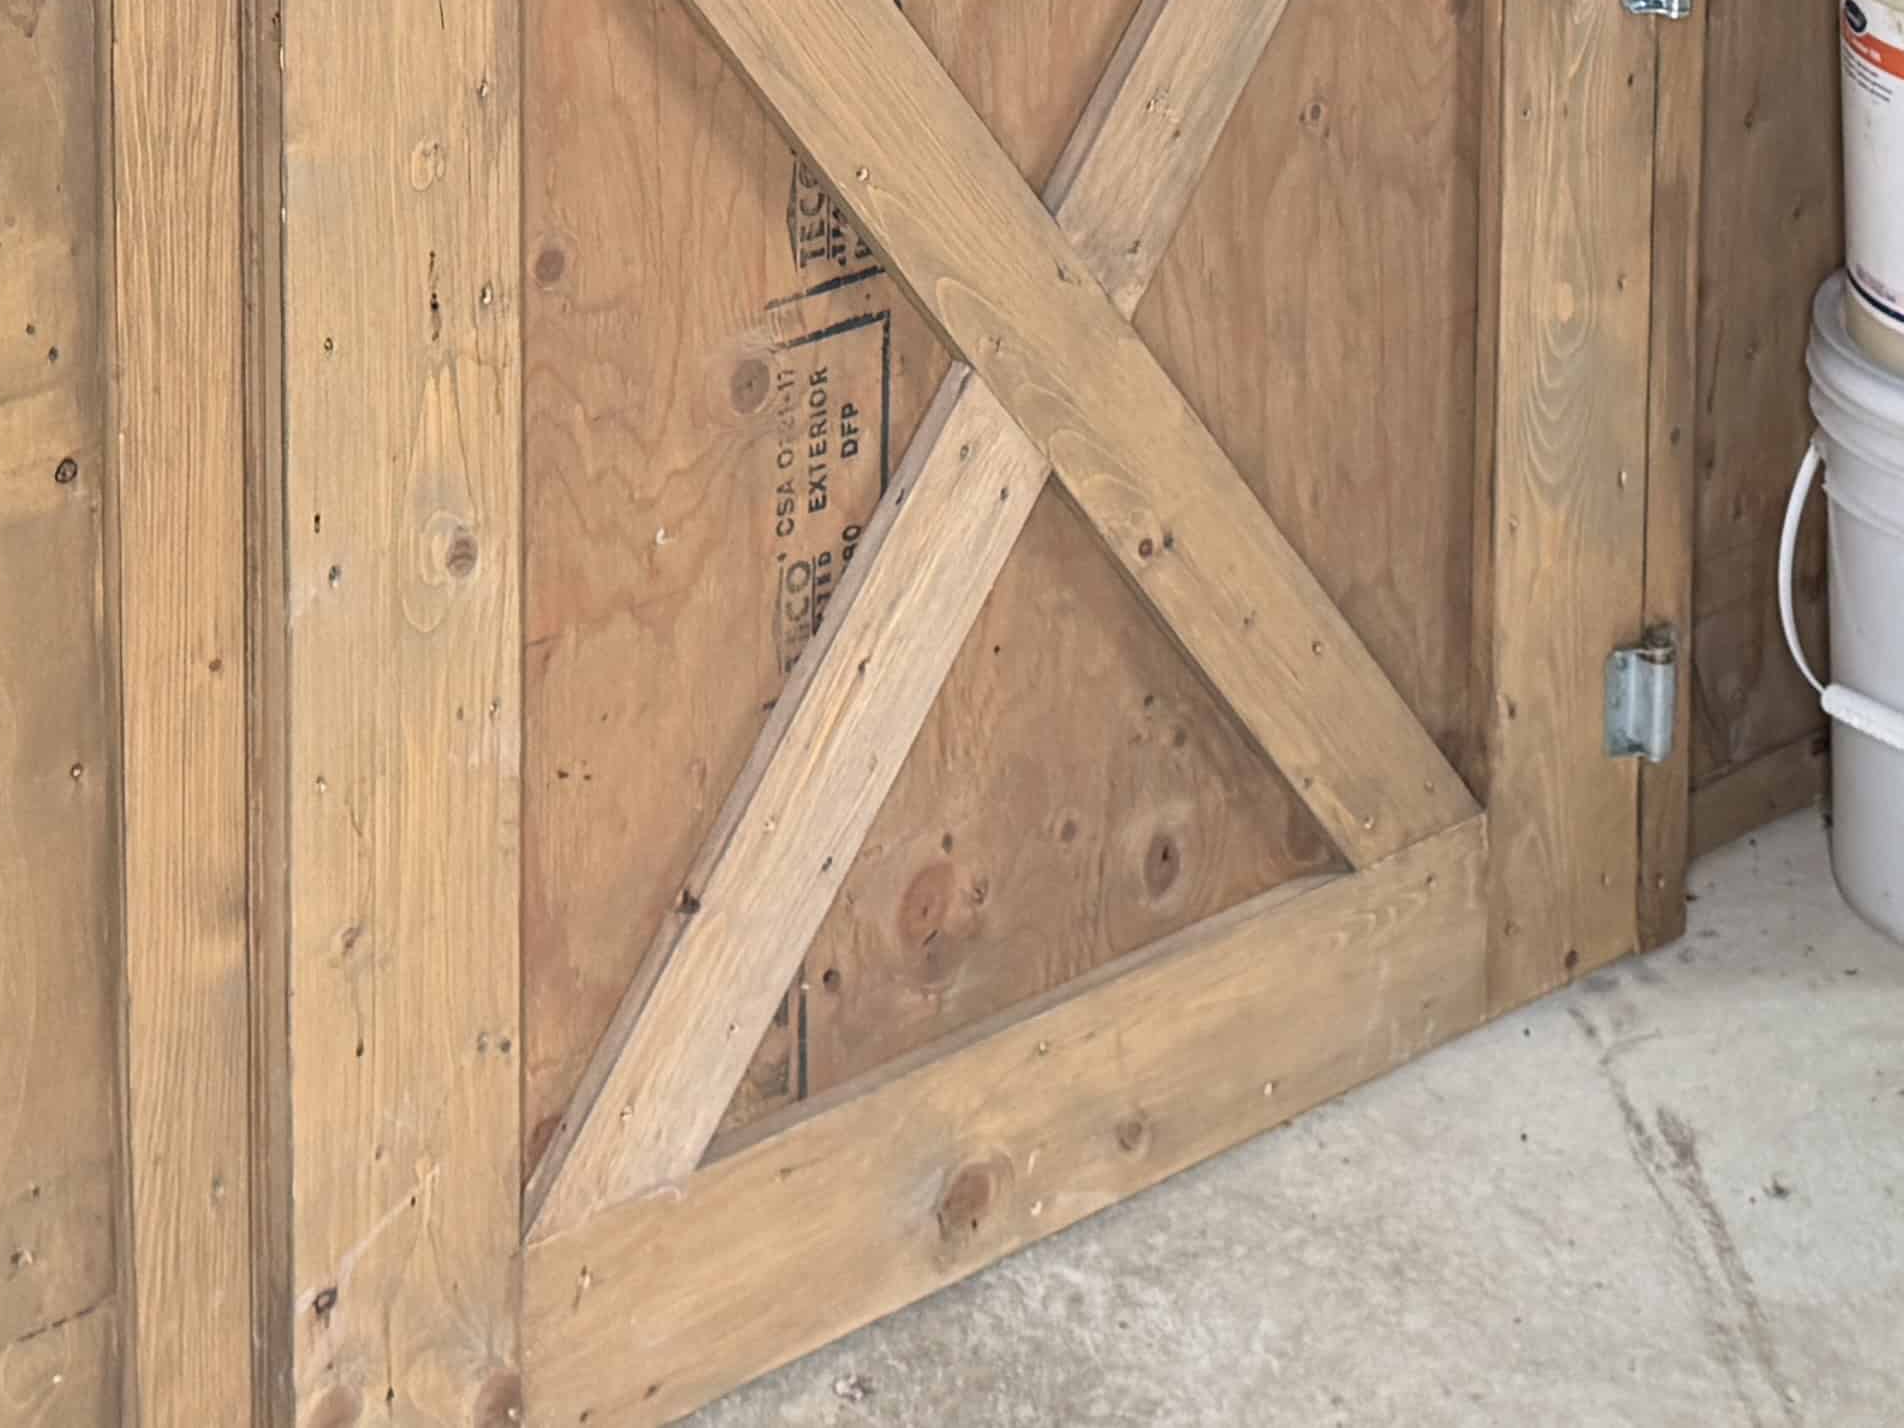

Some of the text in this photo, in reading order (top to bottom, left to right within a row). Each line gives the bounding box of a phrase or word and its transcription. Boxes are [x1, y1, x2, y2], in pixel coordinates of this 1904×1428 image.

[808, 365, 828, 514] EXTERIOR
[840, 402, 859, 459] DFP
[776, 479, 795, 538] CSA
